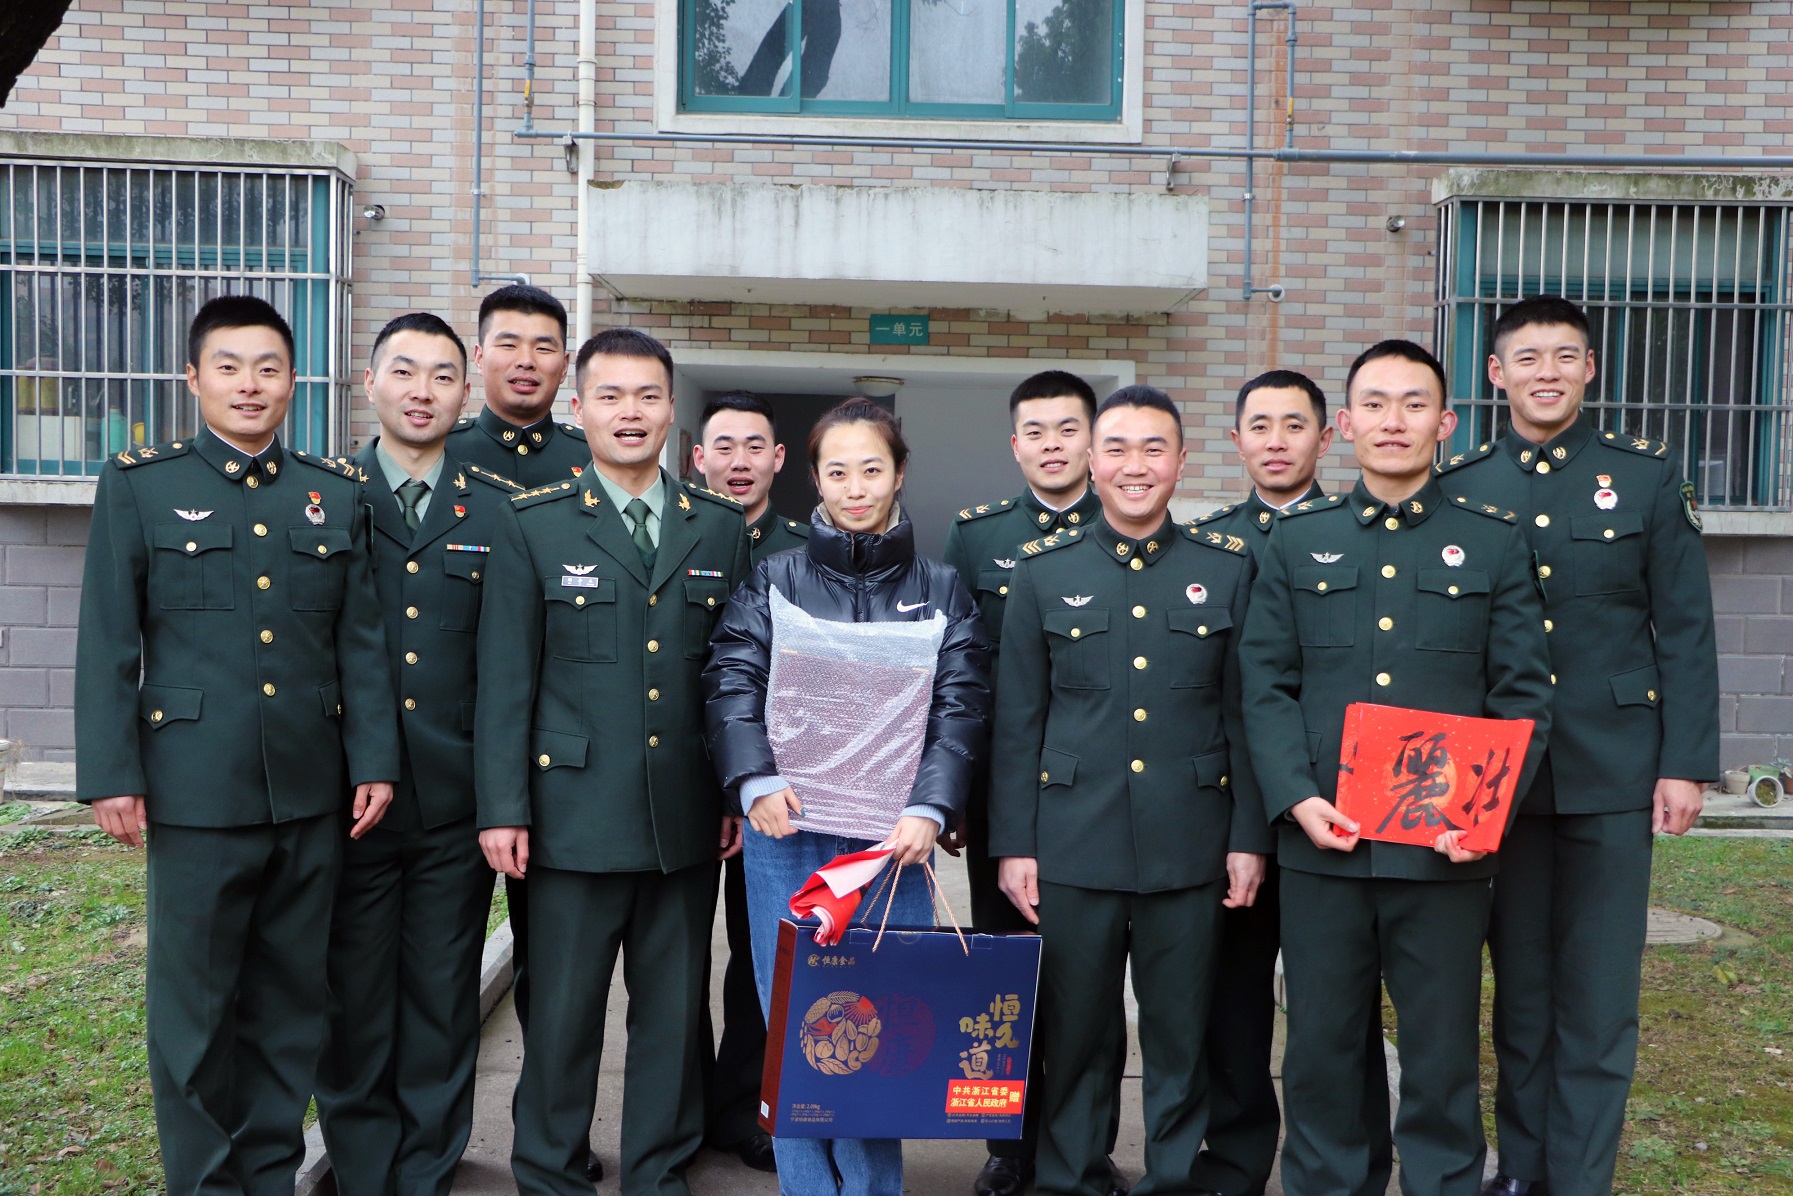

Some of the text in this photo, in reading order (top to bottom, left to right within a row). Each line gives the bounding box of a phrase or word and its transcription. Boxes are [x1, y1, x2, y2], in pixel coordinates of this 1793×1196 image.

[875, 322, 923, 337] 一单元
[952, 1085, 1009, 1096] 中共浙江省委
[950, 1097, 1007, 1108] 浙江省人民政府
[1008, 1091, 1021, 1103] 赠
